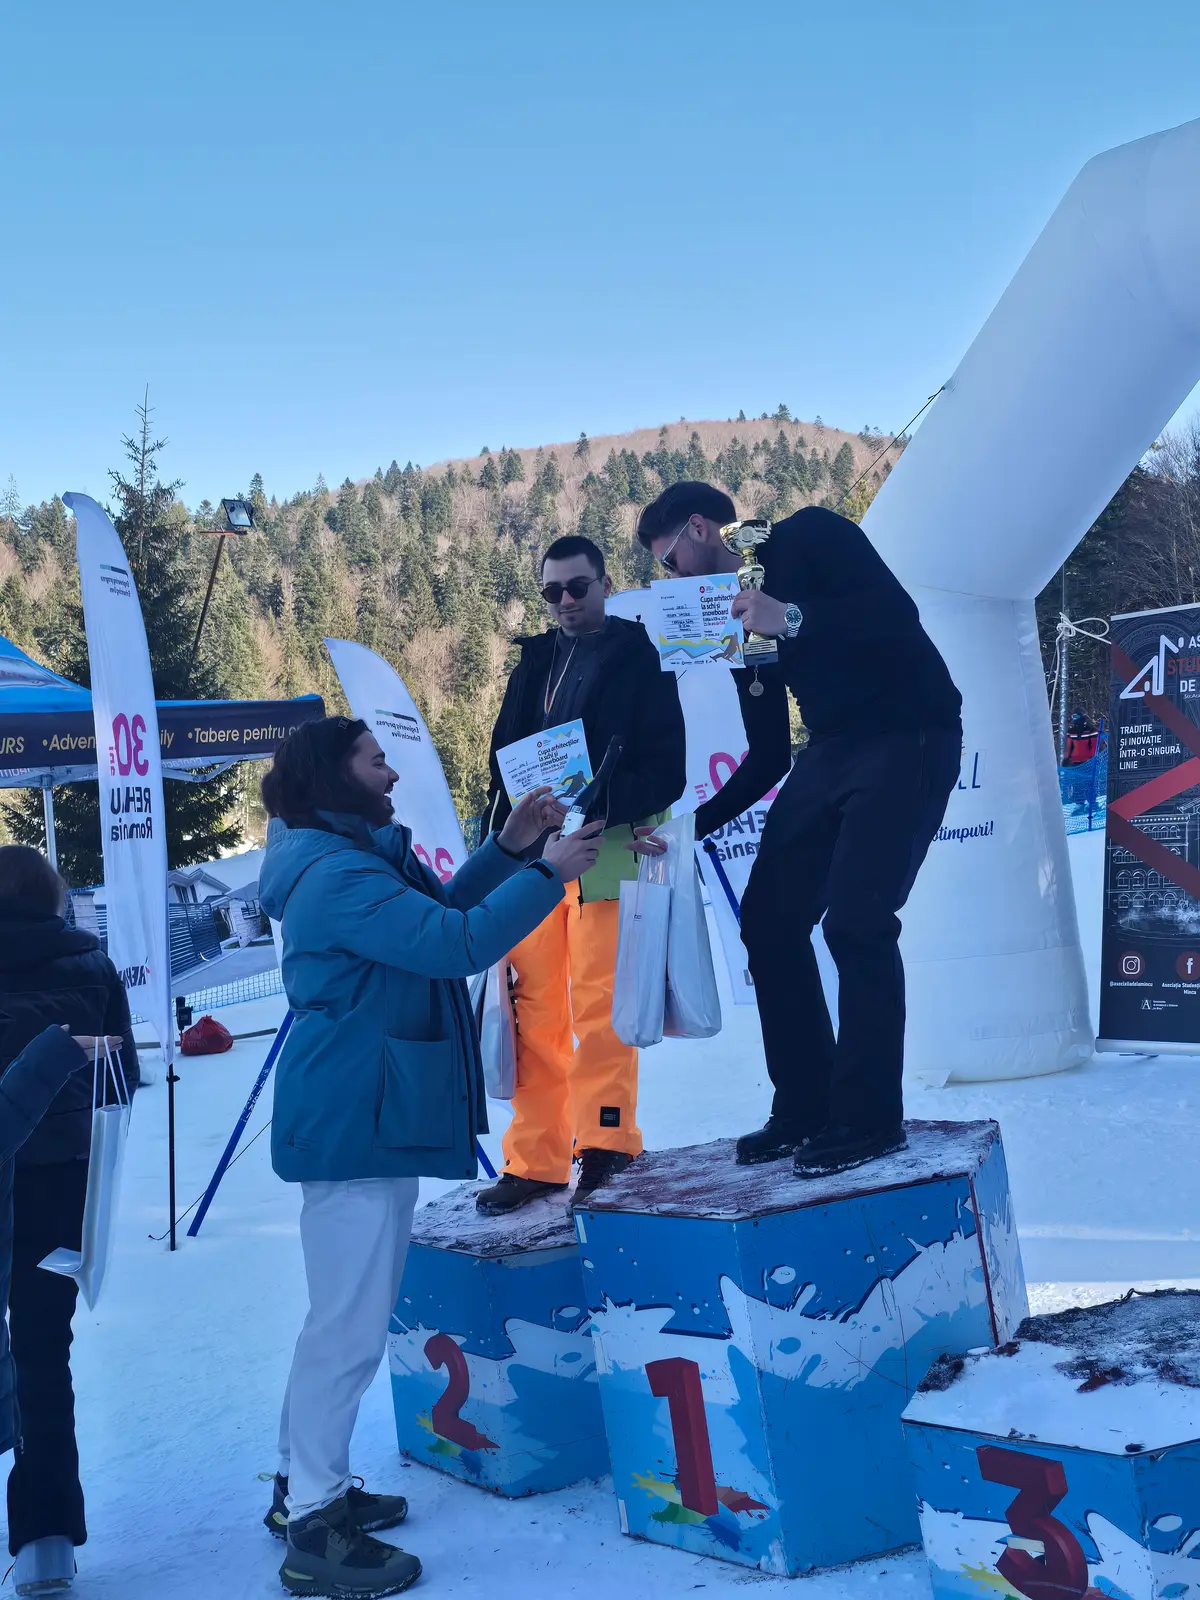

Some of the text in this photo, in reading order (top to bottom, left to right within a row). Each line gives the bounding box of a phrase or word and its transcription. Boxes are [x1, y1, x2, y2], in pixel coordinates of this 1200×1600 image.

[700, 596, 713, 604] Cupa
[706, 602, 716, 610] schi
[702, 608, 729, 617] snowboard
[1179, 679, 1196, 693] DE
[194, 727, 240, 743] Tabere
[243, 724, 285, 744] pentru
[1120, 723, 1153, 735] TRADIȚIE
[1128, 734, 1162, 747] INOVAȚIE
[537, 746, 551, 756] Cupa
[1119, 743, 1181, 758] ÎNTR-O SINGURĂ
[539, 753, 568, 767] snowboard
[1119, 760, 1138, 770] LINIE
[423, 1333, 501, 1452] 2
[645, 1356, 720, 1517] 1
[975, 1444, 1089, 1600] 3
